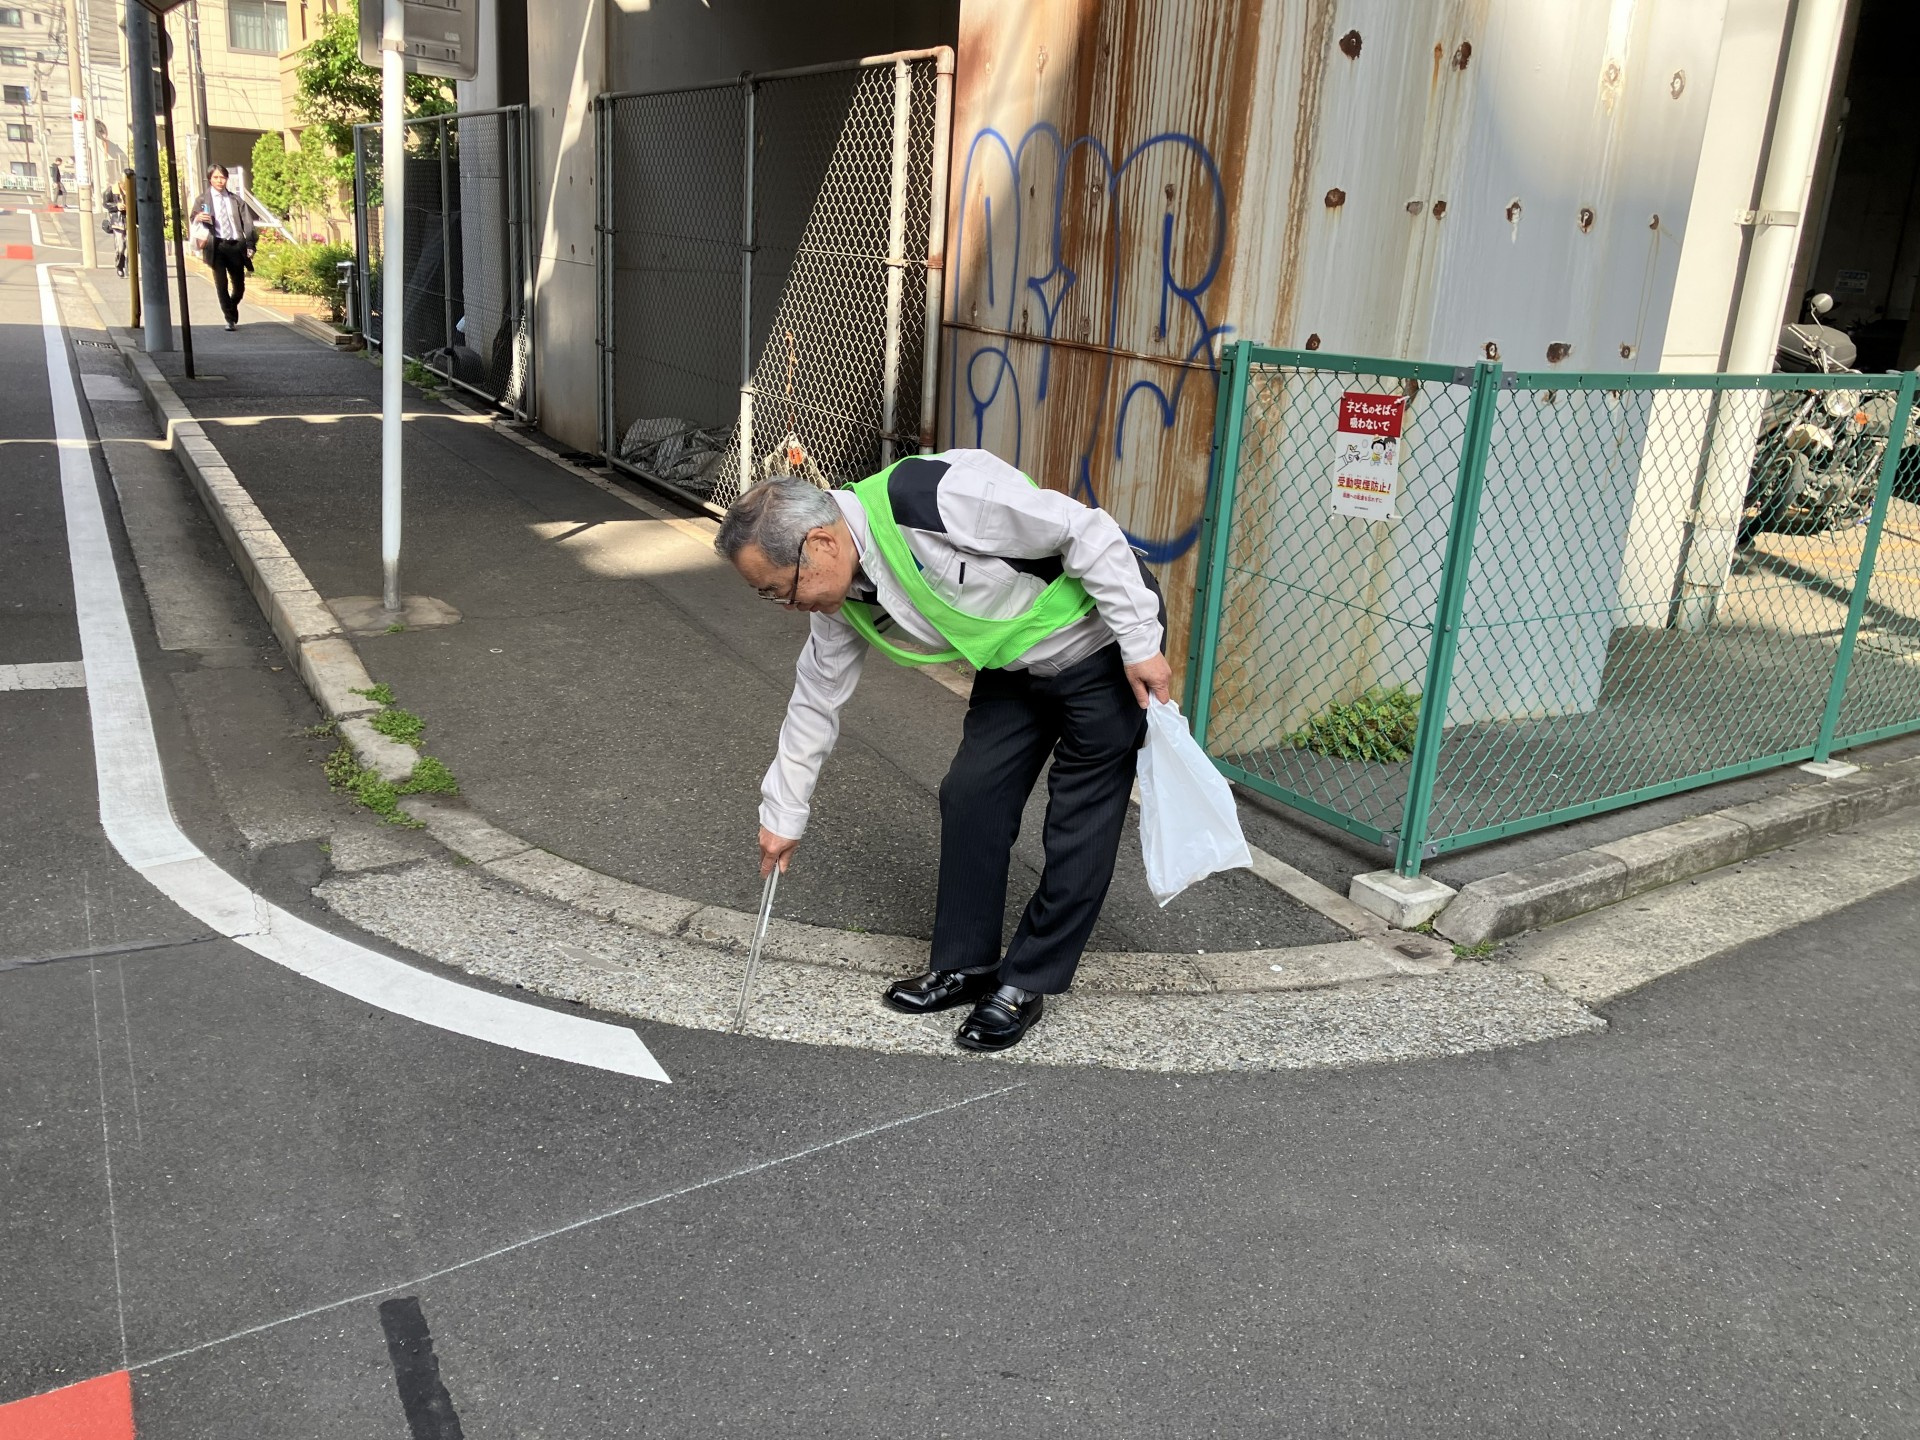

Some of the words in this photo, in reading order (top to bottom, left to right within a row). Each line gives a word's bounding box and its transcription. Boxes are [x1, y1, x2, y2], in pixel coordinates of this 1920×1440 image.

[1346, 401, 1397, 416] 子どものそばで
[1349, 417, 1390, 431] 吸わないで
